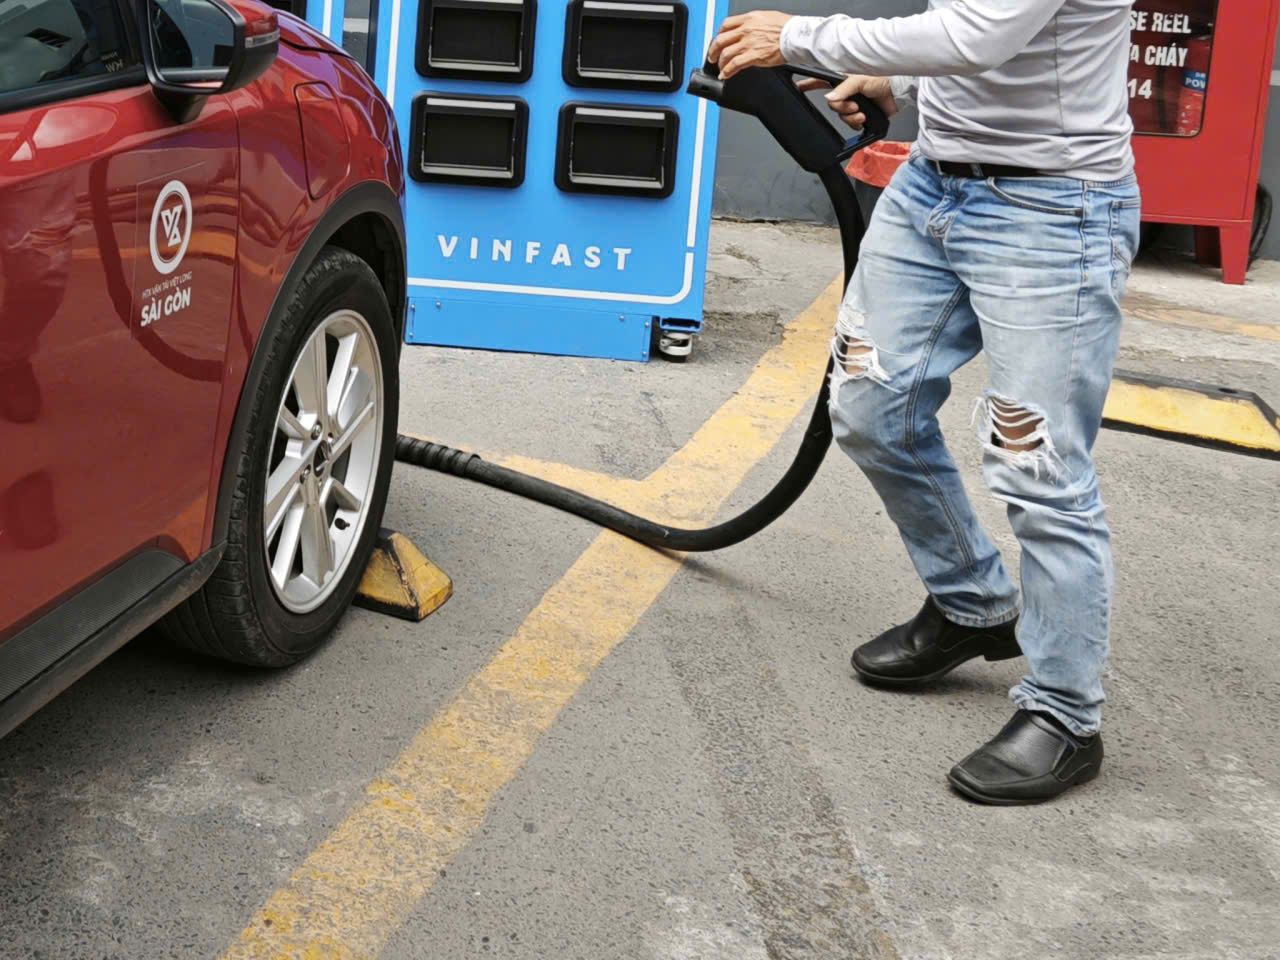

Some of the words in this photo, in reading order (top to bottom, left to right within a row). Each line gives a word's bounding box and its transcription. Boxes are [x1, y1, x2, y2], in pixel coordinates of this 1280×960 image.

[1152, 12, 1191, 34] REEL
[1145, 43, 1188, 67] CHÁY
[437, 234, 632, 271] VINFAST
[140, 297, 162, 327] SÀI
[164, 287, 192, 316] GÒN
